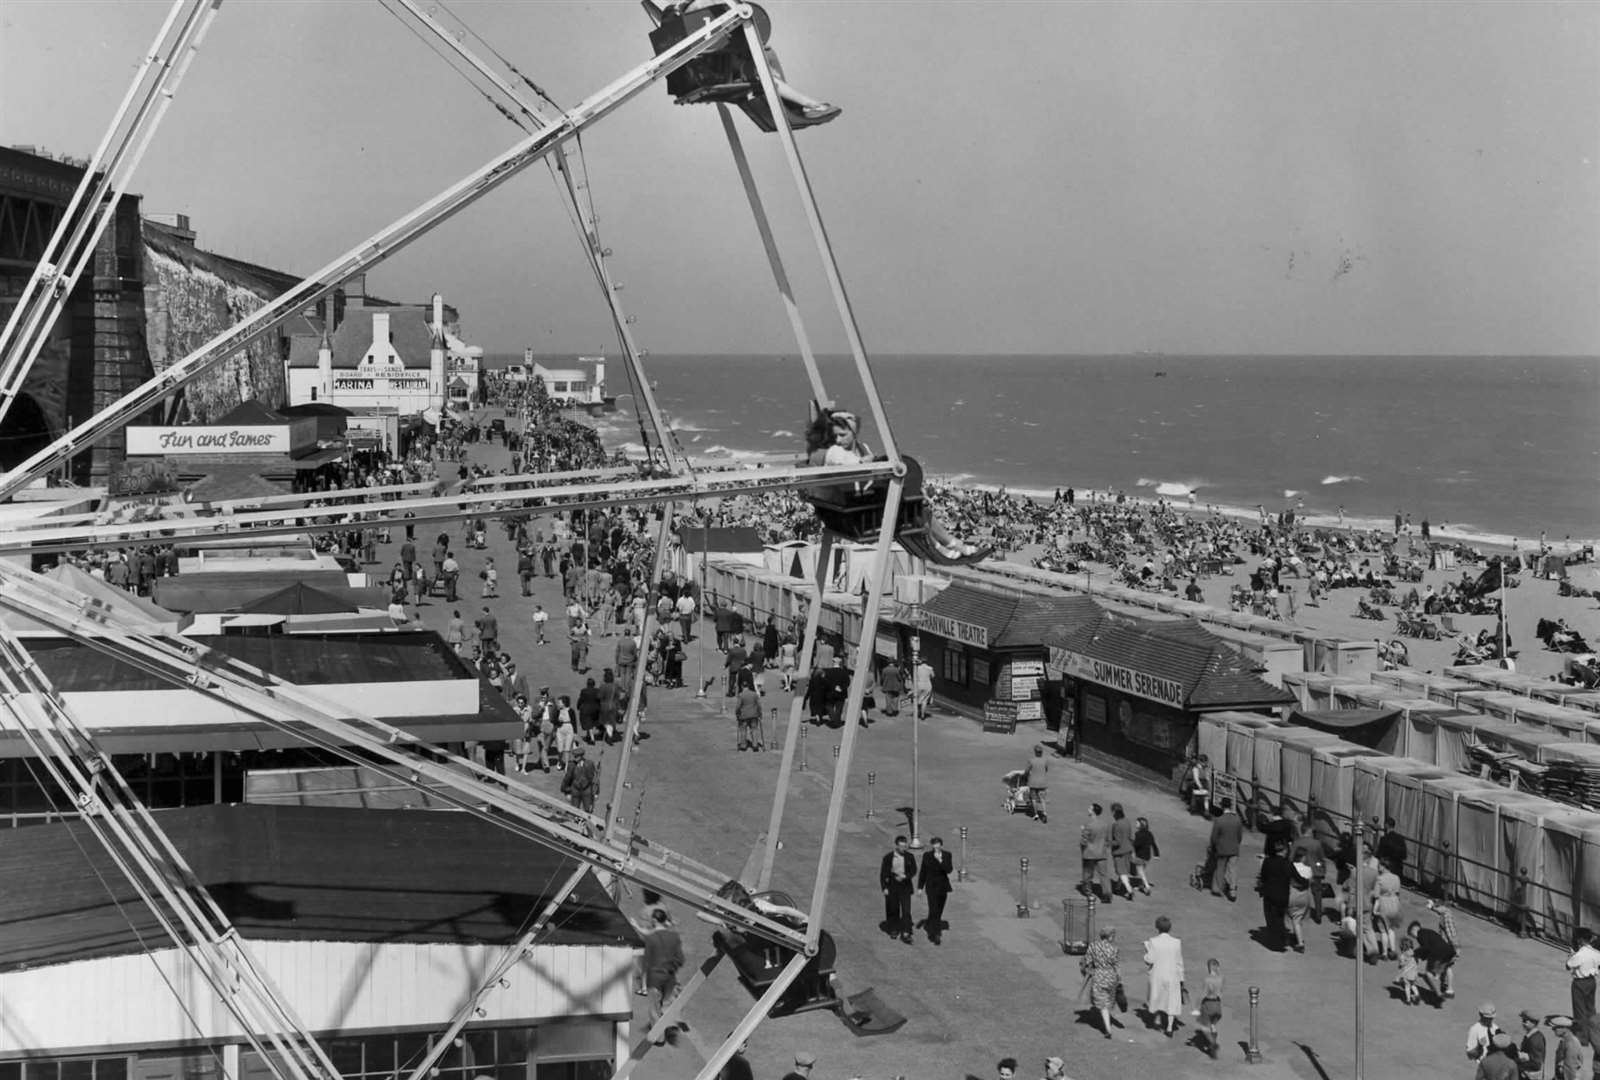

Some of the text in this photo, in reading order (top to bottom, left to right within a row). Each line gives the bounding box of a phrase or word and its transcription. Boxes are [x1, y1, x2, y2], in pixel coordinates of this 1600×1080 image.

[334, 379, 374, 390] MARINA
[159, 431, 276, 449] Fun and Games
[957, 622, 985, 646] THEATRE
[1093, 661, 1133, 689] SUMMER
[1134, 675, 1182, 704] SERENADE
